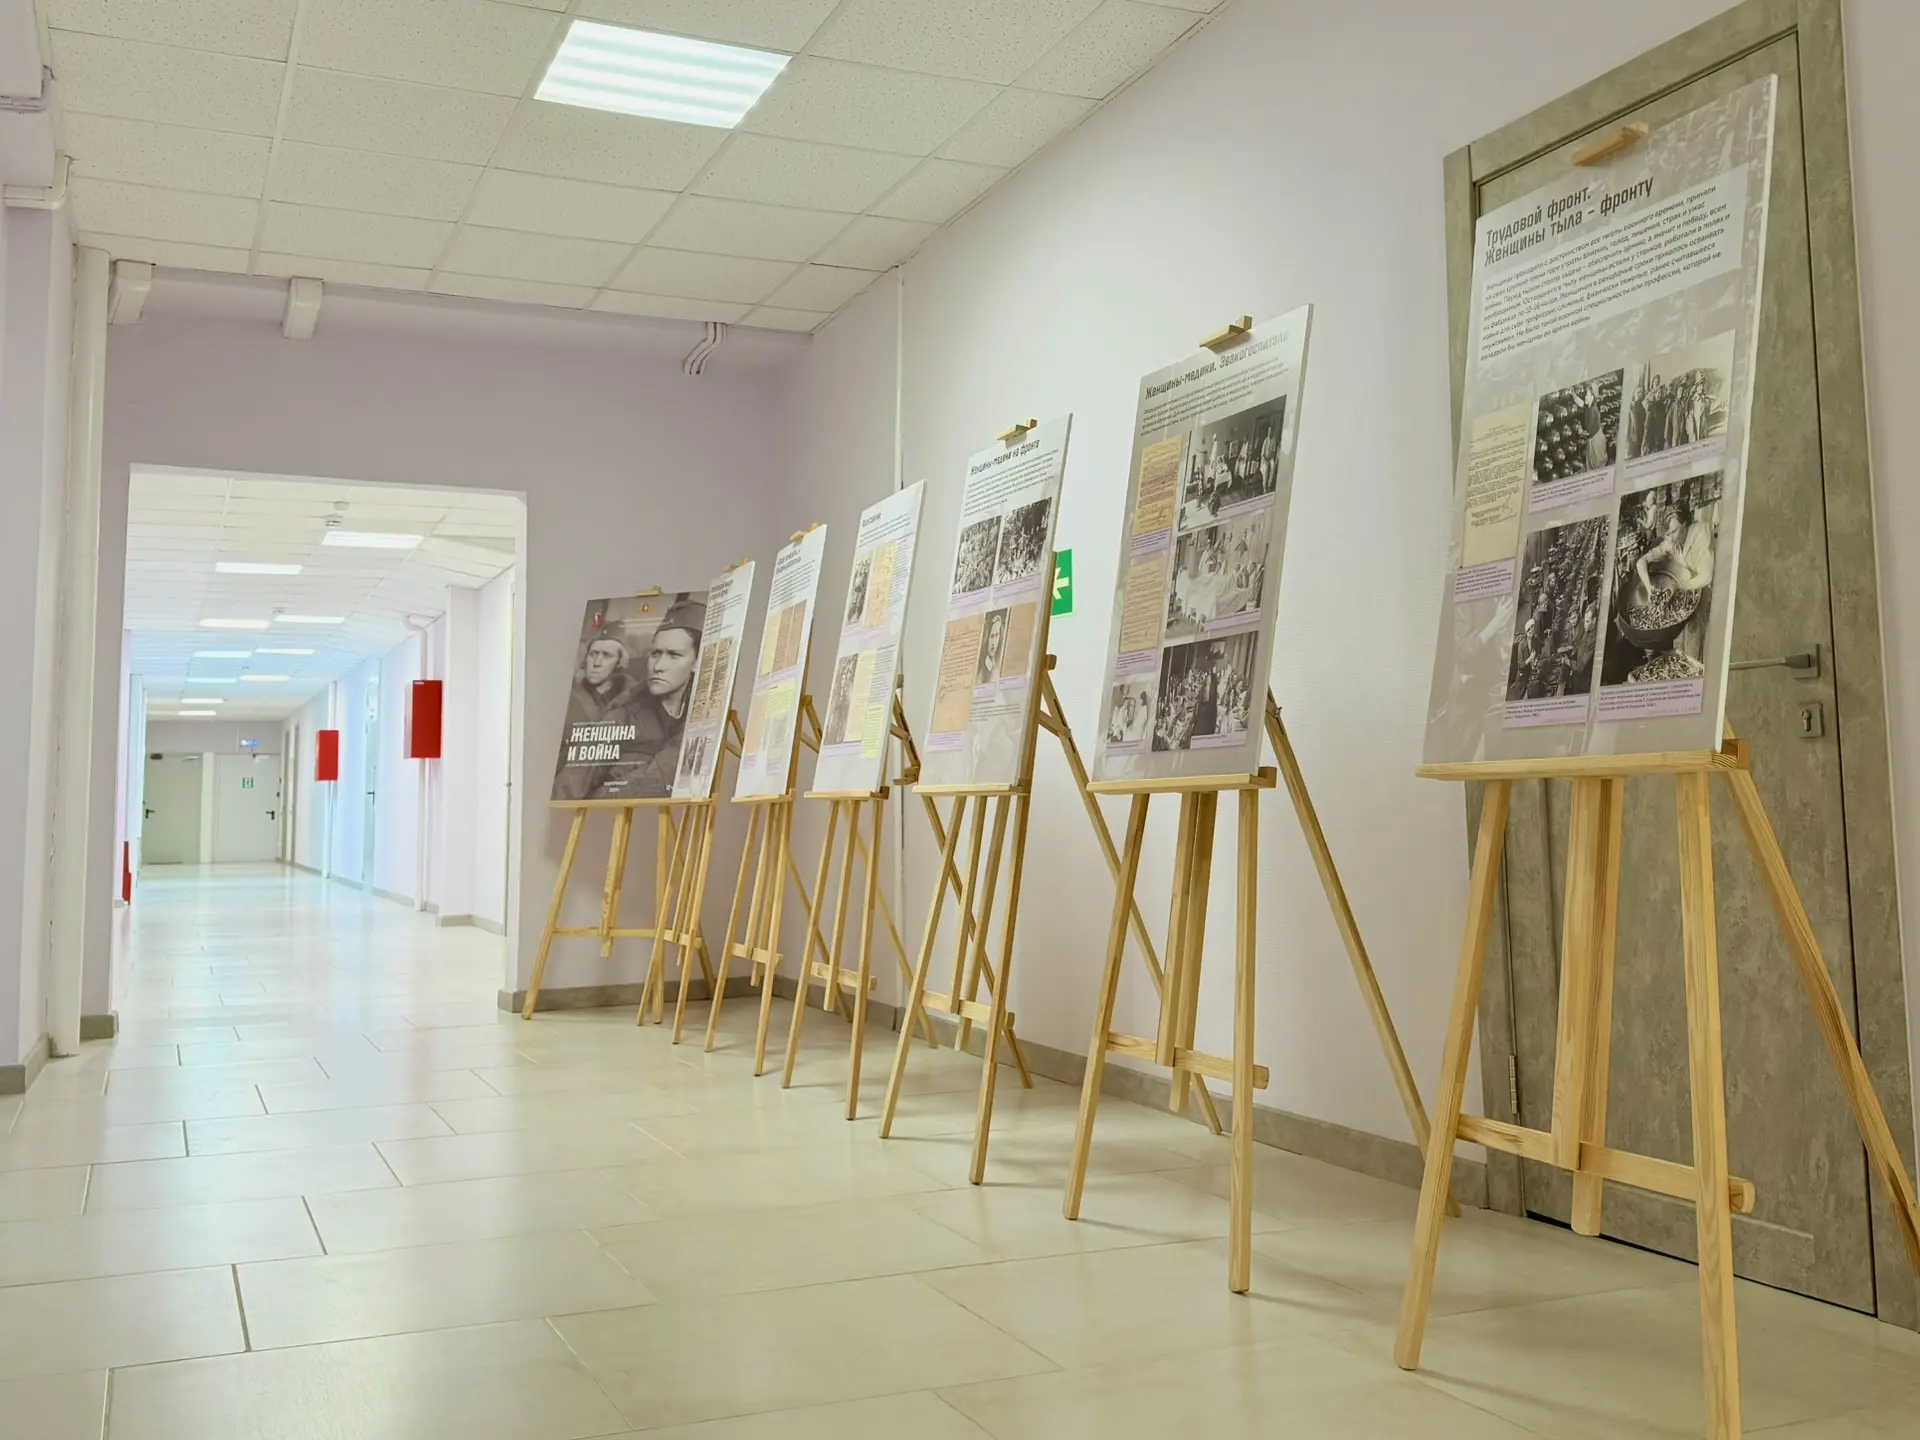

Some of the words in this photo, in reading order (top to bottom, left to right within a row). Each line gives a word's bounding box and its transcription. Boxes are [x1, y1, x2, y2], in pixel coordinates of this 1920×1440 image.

[1484, 228, 1546, 267] Женщины
[1550, 210, 1583, 236] тыла
[1600, 176, 1654, 216] фронту
[1486, 205, 1543, 249] Трудовой
[1547, 186, 1591, 221] фронт.
[1145, 361, 1217, 399] Женщины-медики.
[567, 746, 577, 761] И
[578, 742, 620, 761] ВОЙНА
[570, 725, 636, 743] ЖЕНЩИНА
